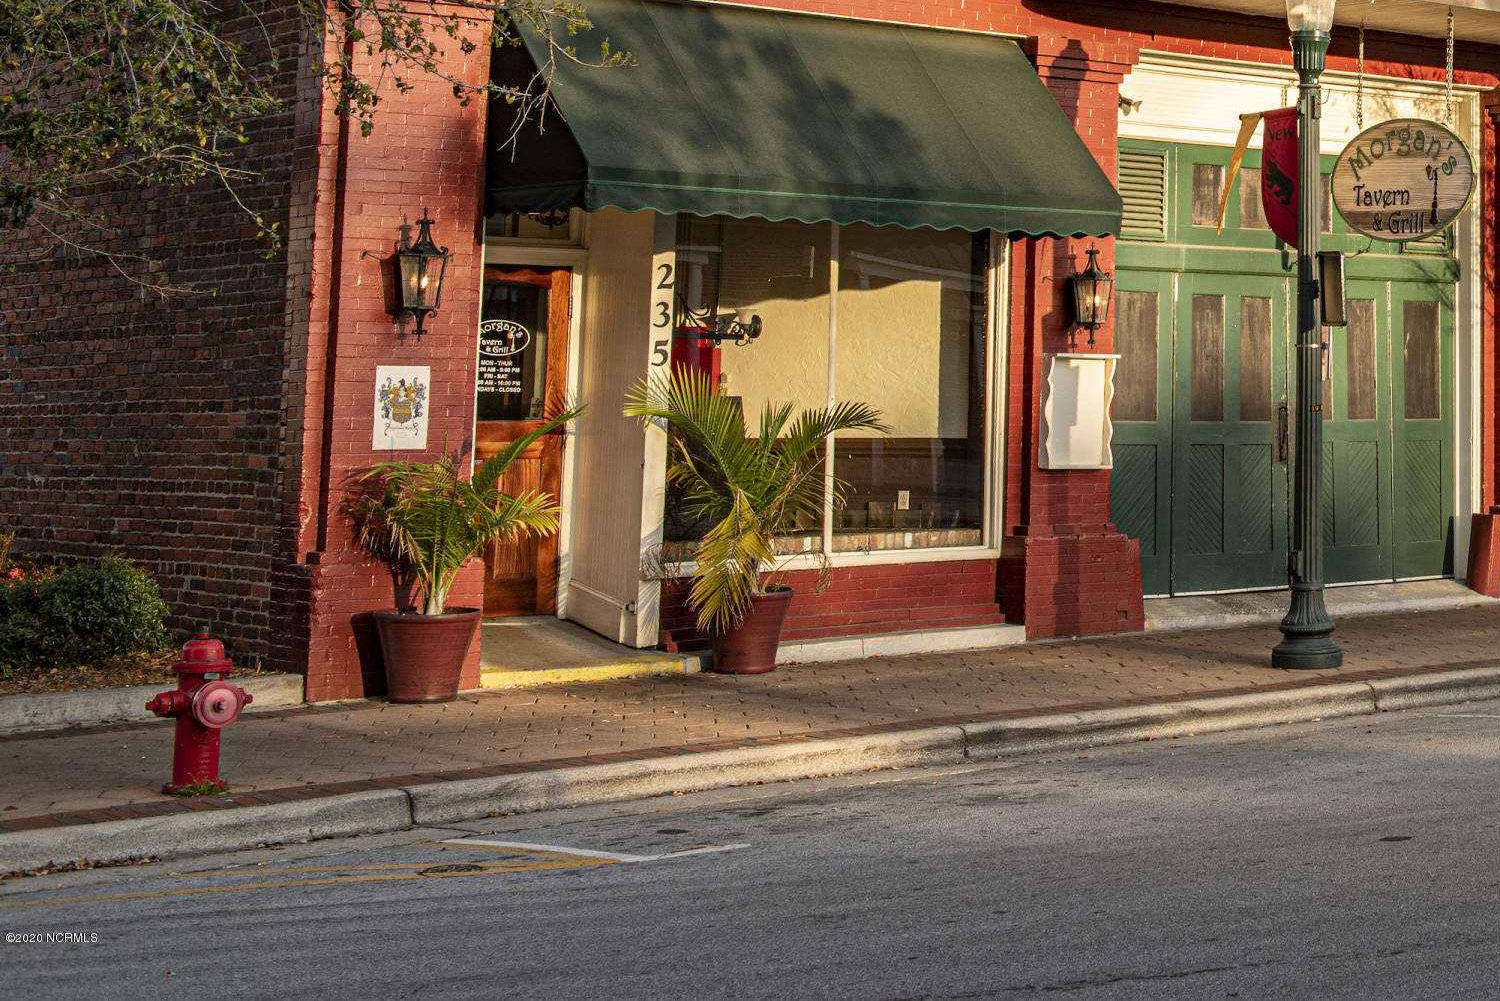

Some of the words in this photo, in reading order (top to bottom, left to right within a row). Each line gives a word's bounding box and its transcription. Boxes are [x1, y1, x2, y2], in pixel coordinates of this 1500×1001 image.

[1266, 125, 1296, 142] New
[1348, 124, 1457, 181] Morgan's
[1353, 183, 1410, 208] Tavern
[1372, 215, 1384, 231] &
[1388, 212, 1426, 234] Grill
[480, 337, 502, 345] avern
[492, 345, 509, 353] Grill
